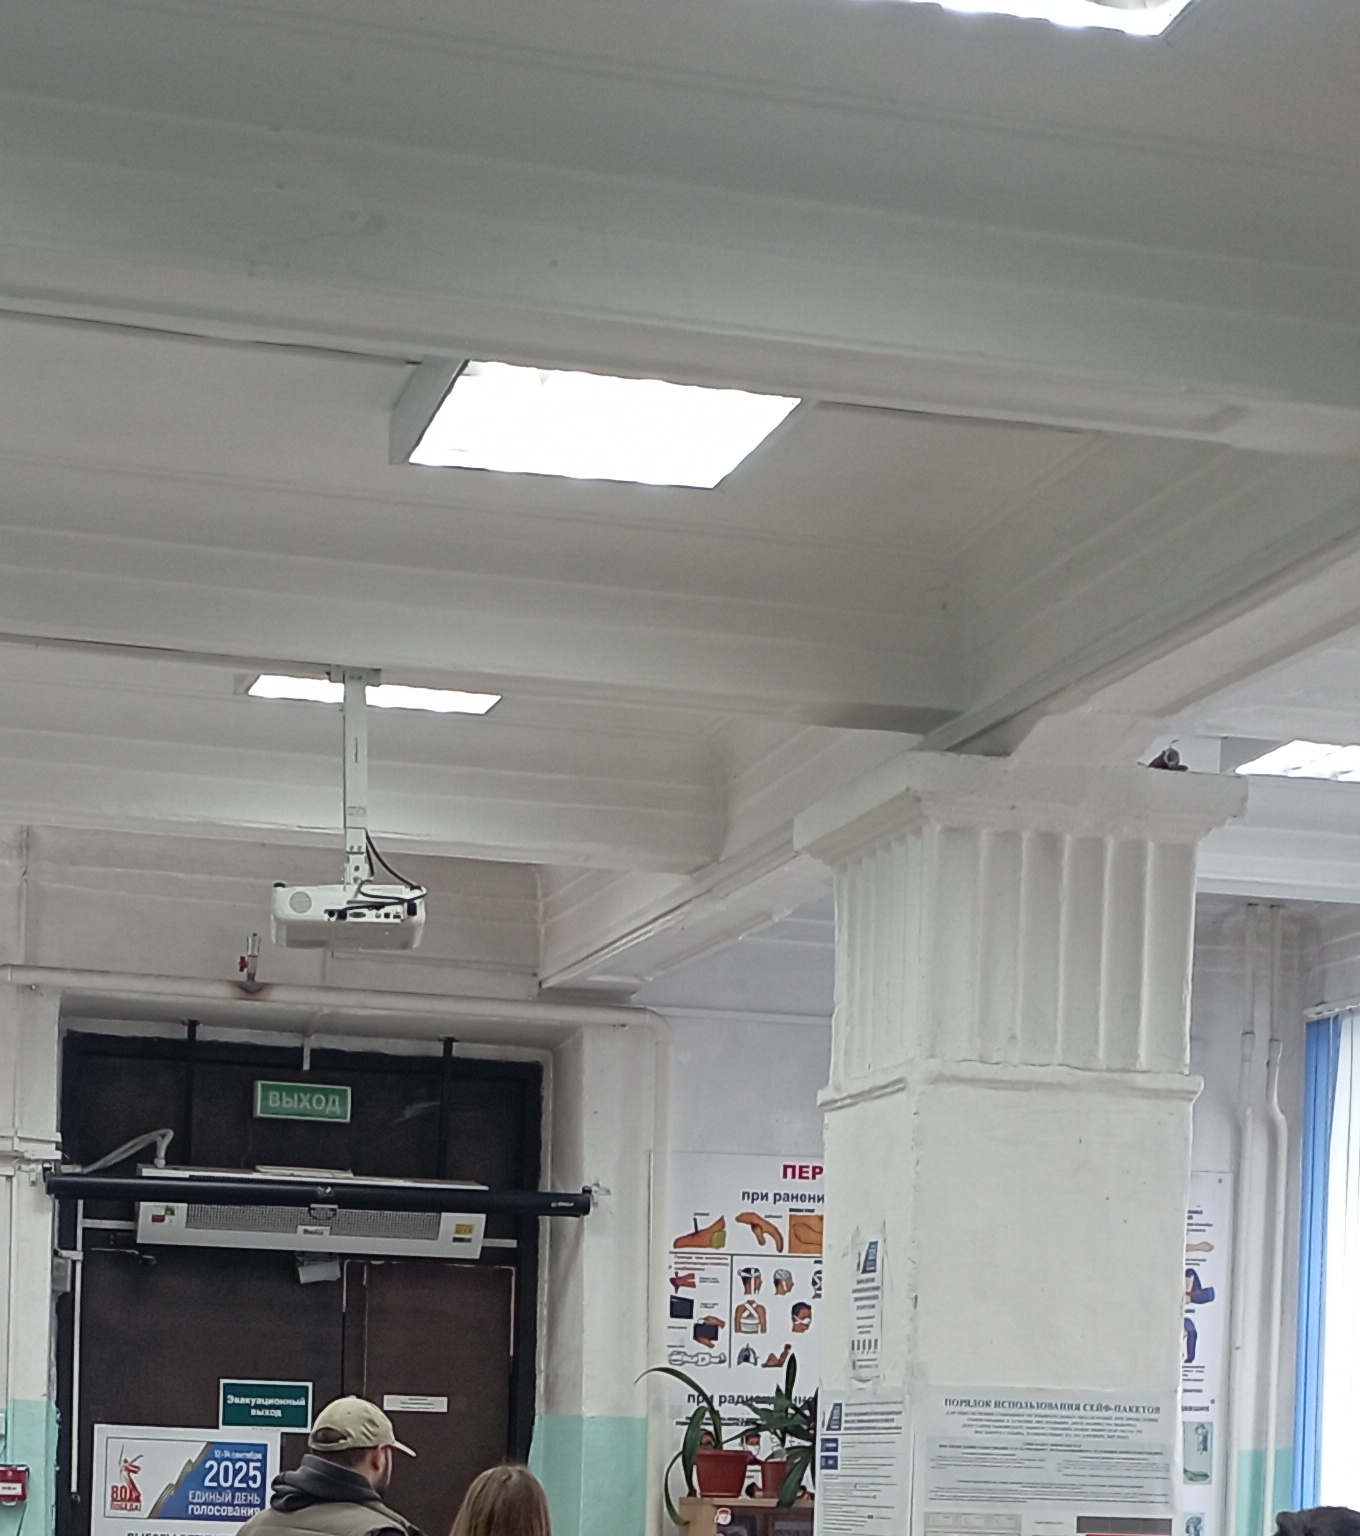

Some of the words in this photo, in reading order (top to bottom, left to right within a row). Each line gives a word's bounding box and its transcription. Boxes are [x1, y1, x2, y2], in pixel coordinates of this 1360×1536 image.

[269, 1091, 340, 1114] ВЫХОД
[782, 1164, 824, 1180] ПЕР
[742, 1191, 768, 1204] при
[226, 1394, 306, 1407] Эвакуационный
[944, 1398, 992, 1408] ПОРЯДОК
[250, 1408, 282, 1418] выход
[203, 1460, 262, 1489] 2025
[189, 1489, 232, 1503] ЕДИНЫЙ
[234, 1492, 261, 1504] ДЕНЬ
